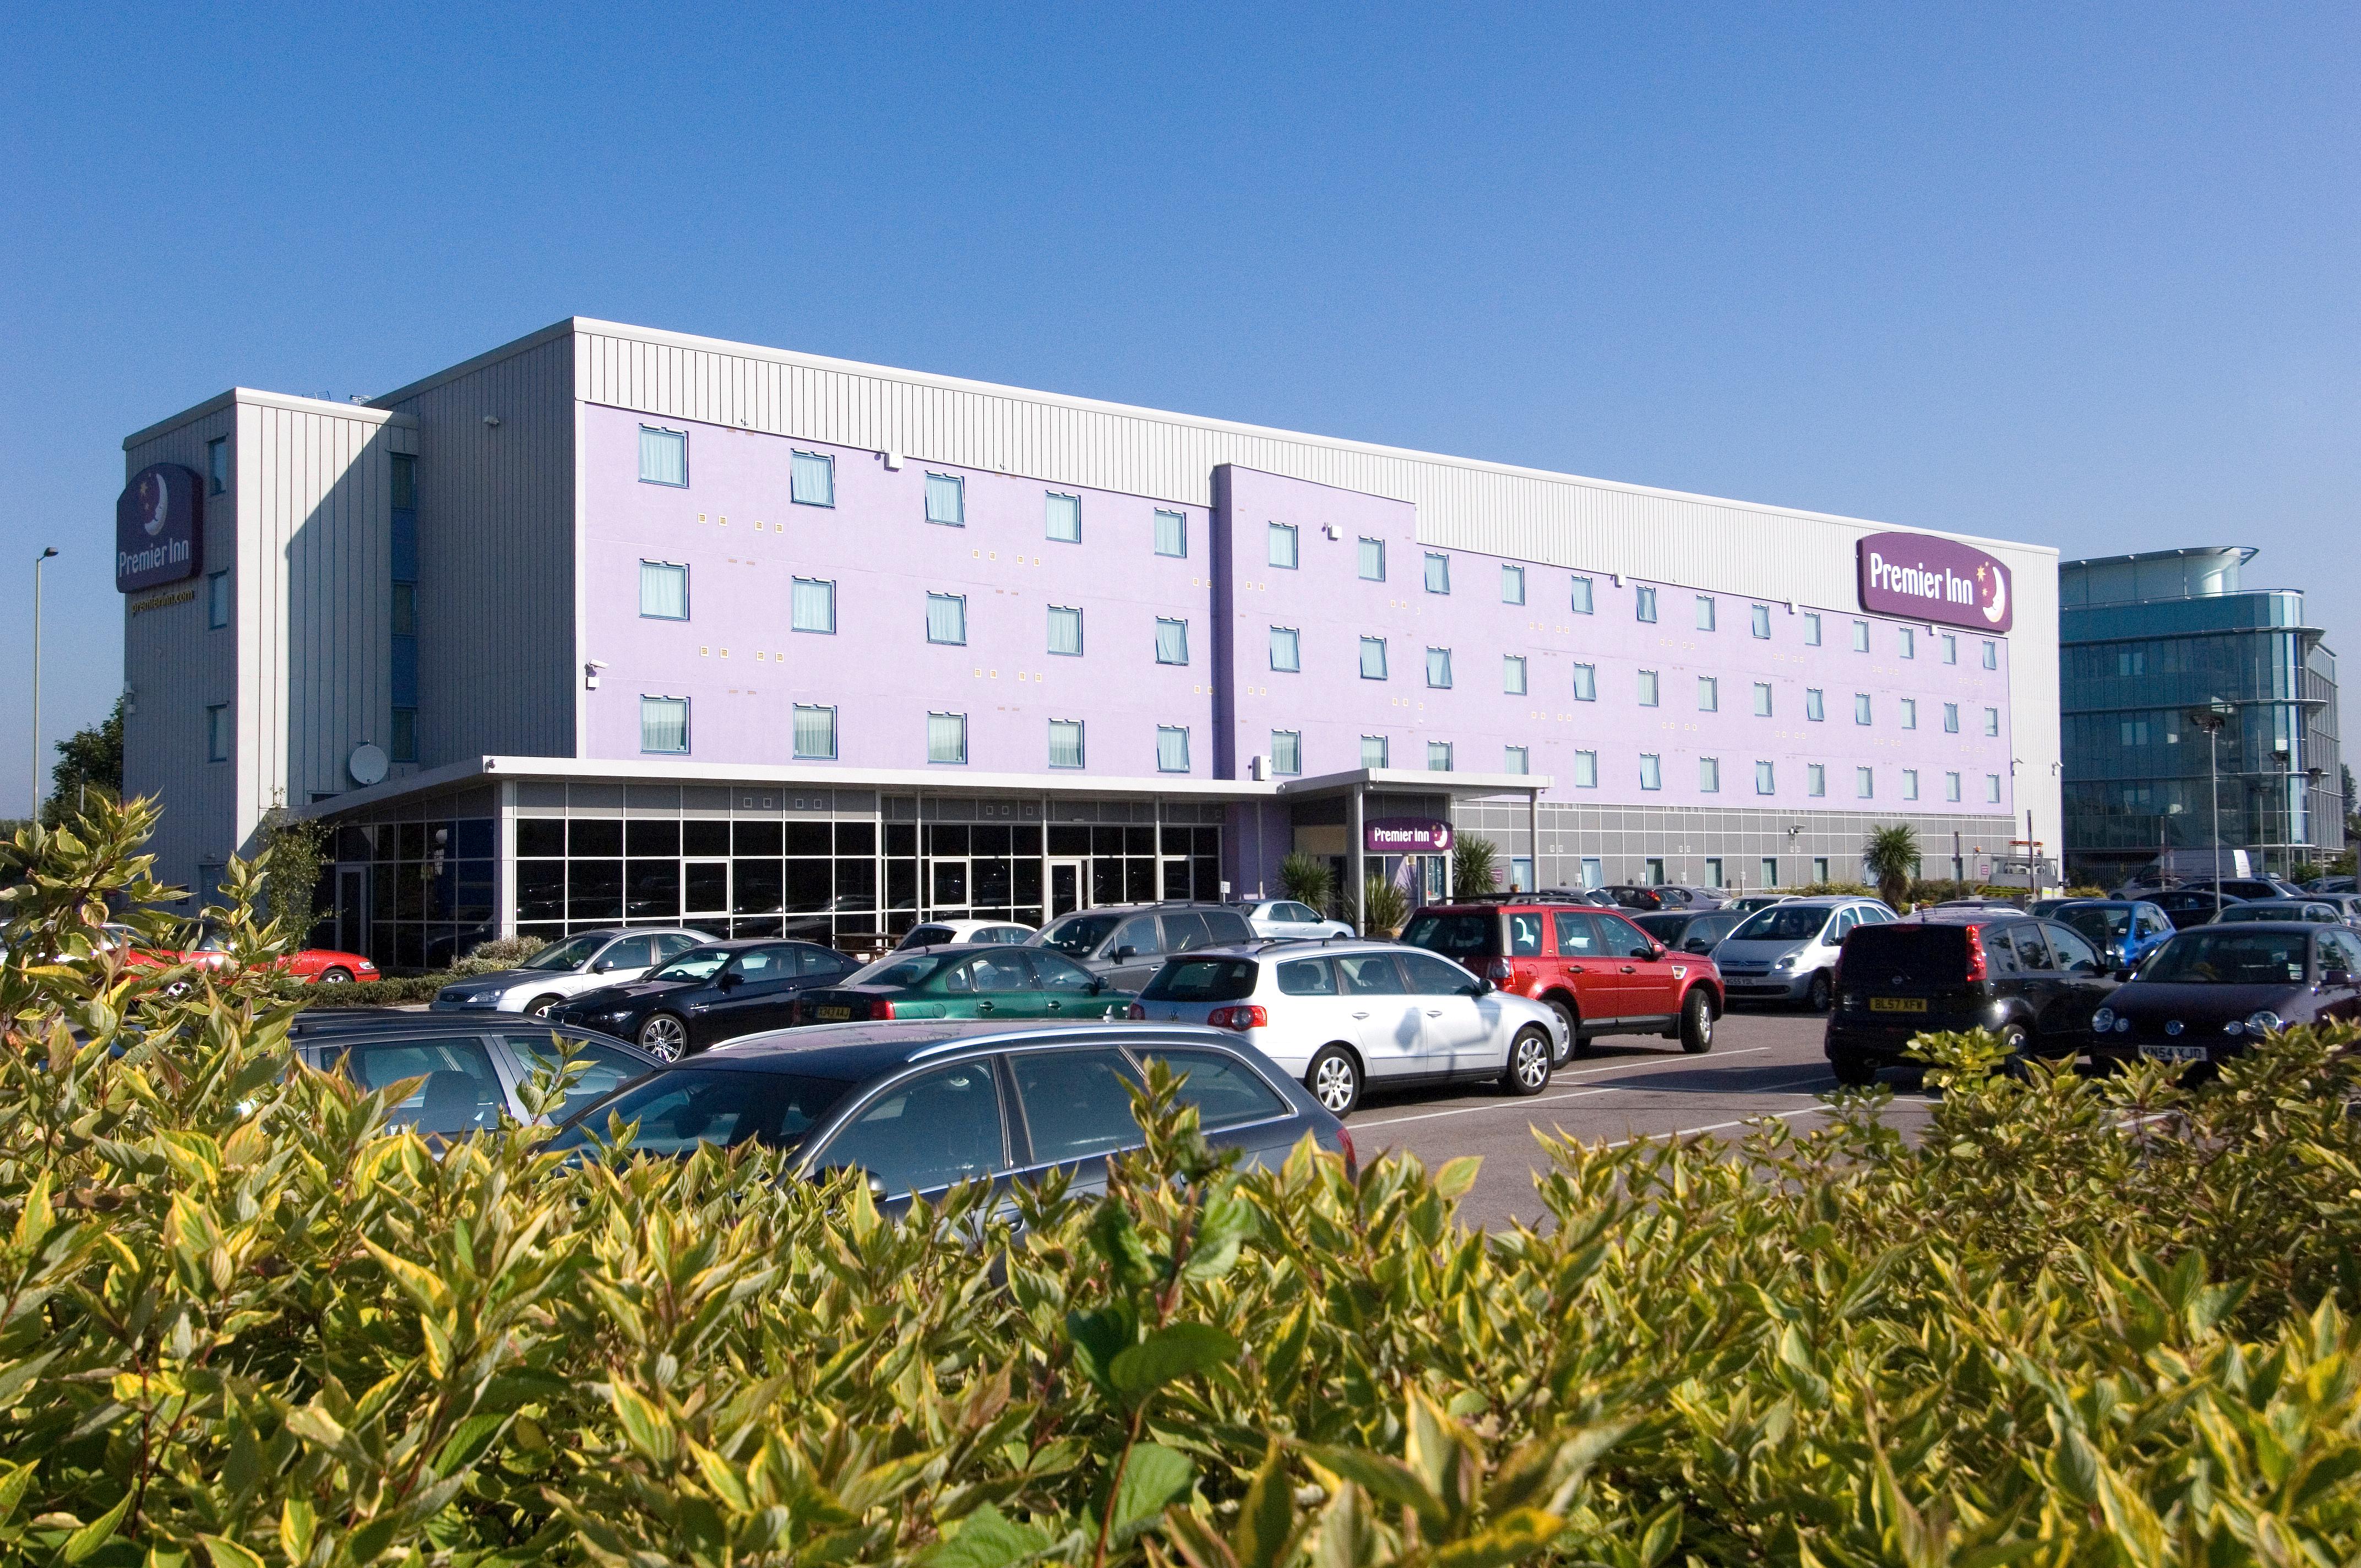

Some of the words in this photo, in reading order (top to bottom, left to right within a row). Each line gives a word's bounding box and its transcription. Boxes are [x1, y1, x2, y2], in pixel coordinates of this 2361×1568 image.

[118, 543, 167, 577] Premier
[169, 537, 189, 563] Inn
[1870, 552, 1943, 599] Premier
[1946, 568, 1973, 605] Inn
[1374, 827, 1413, 842] Premier
[1415, 828, 1429, 842] Inn
[1875, 999, 1900, 1009] BL57
